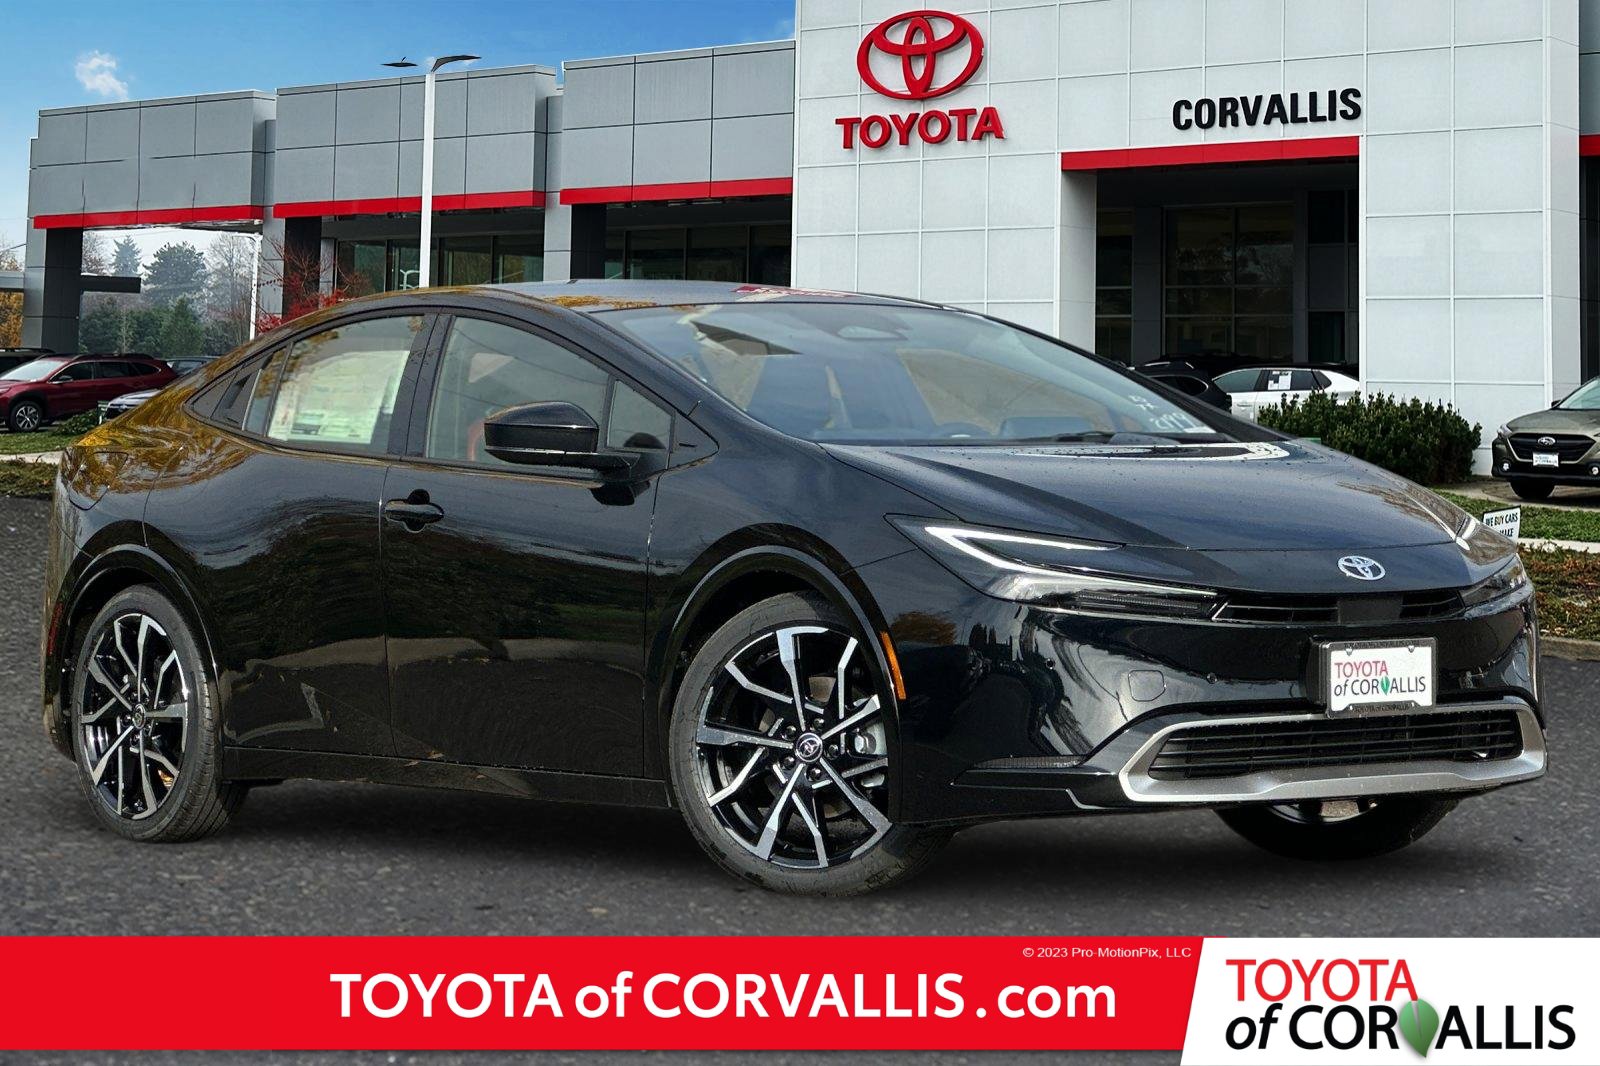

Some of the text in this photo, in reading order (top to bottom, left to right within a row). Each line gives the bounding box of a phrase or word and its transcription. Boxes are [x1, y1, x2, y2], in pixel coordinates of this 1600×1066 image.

[1172, 88, 1362, 131] CORVALLIS
[836, 107, 1005, 149] TOYOTA
[1495, 515, 1504, 525] BUY
[1505, 513, 1518, 523] CARS
[1334, 660, 1389, 679] TOYOTA
[1334, 679, 1349, 697] of
